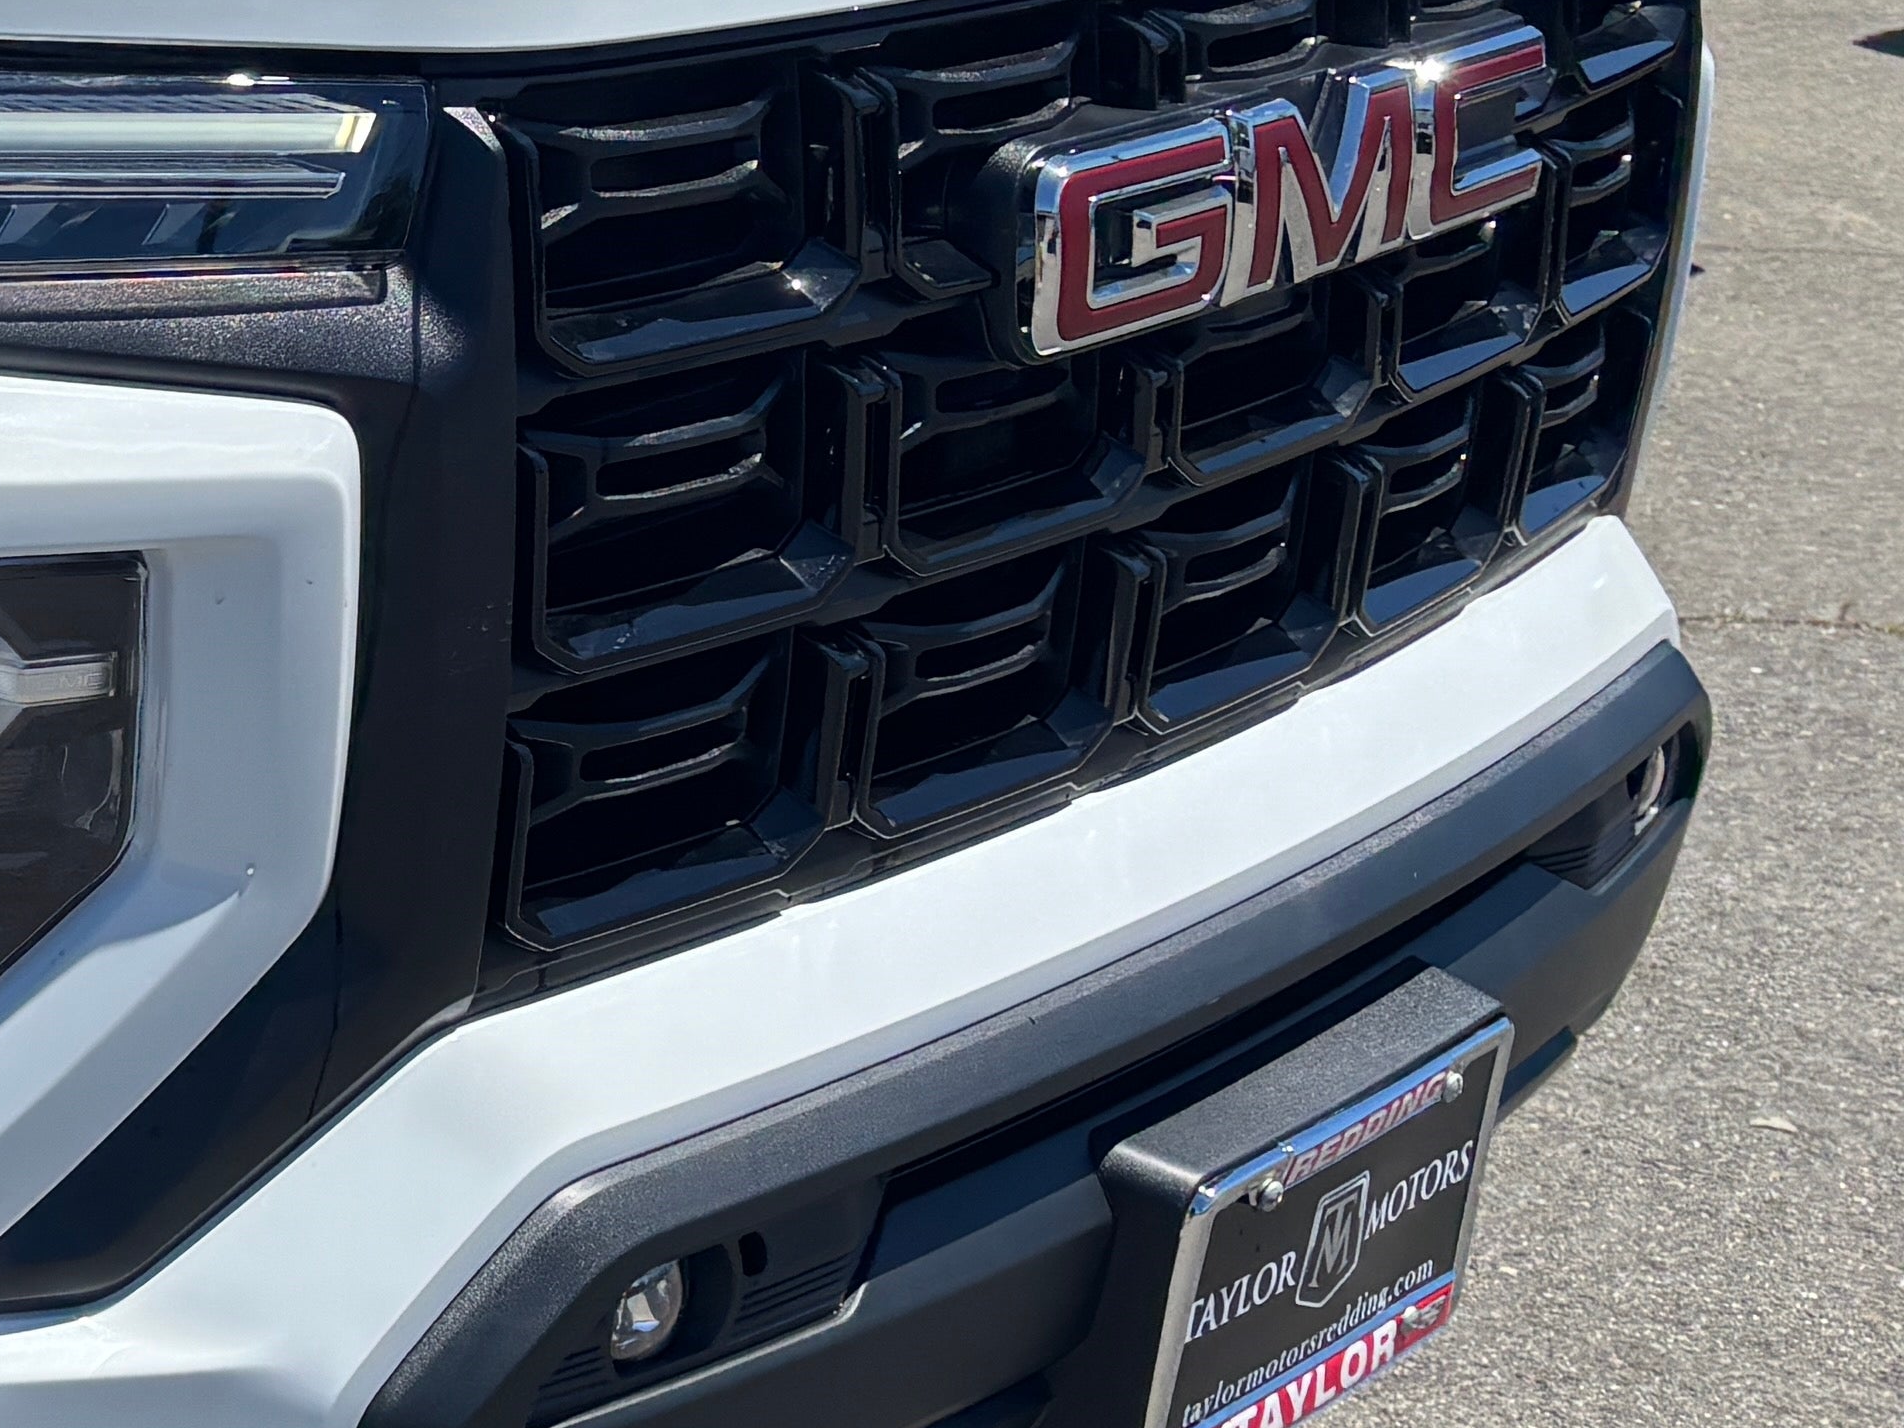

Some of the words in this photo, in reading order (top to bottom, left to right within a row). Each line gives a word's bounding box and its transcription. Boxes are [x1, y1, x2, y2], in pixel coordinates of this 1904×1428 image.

[1034, 24, 1546, 356] GMC
[1287, 1074, 1446, 1181] REDDING
[1184, 1251, 1297, 1343] TAYLOR
[1365, 1139, 1473, 1240] MOTORS
